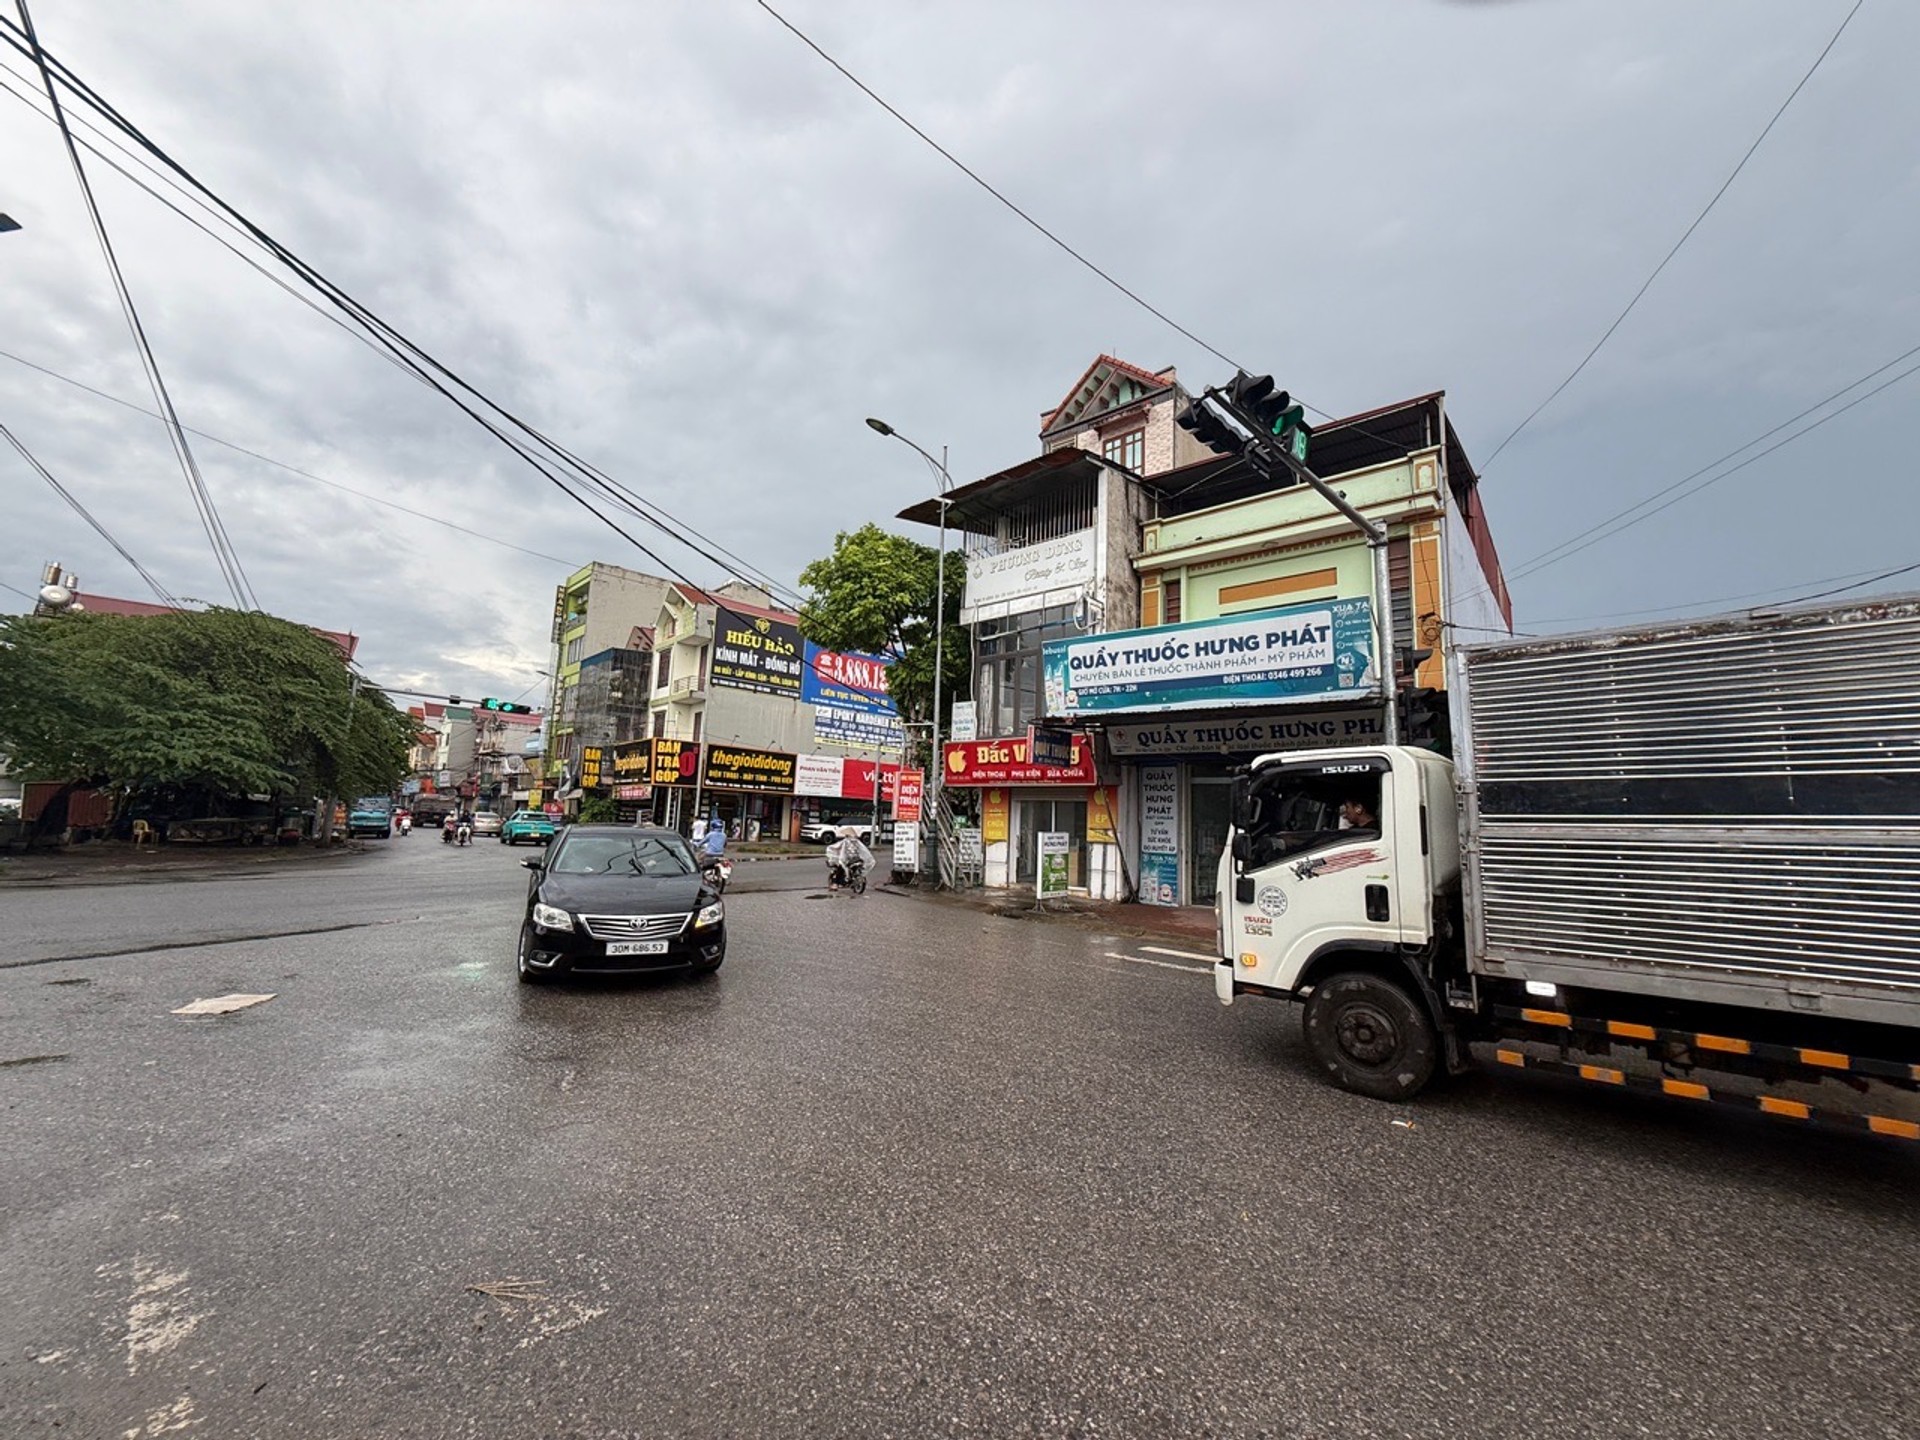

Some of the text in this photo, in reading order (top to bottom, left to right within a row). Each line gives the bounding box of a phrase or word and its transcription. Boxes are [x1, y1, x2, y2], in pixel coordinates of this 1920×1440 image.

[726, 629, 762, 648] HIẾU
[1070, 622, 1331, 671] QUẦY THUỐC HƯNG PHÁT
[715, 646, 738, 663] KÍNH
[740, 650, 758, 667] MẮT
[765, 655, 788, 673] ĐỒNG
[1074, 669, 1110, 682] CHUYÊN
[1112, 667, 1132, 679] BÁN
[1134, 665, 1146, 677] LẺ
[1148, 662, 1182, 676] THUỐC
[1184, 657, 1221, 671] THÀNH
[1224, 653, 1257, 668] PHẨM
[1268, 651, 1285, 664] MỸ
[1289, 647, 1325, 661] PHẨM
[1223, 667, 1322, 685] ĐIỆN THOẠI: 0346 499 266
[1137, 724, 1188, 747] QUẦY
[1193, 720, 1264, 743] THUỐC
[1269, 720, 1336, 739] HƯNG
[657, 740, 682, 754] BÁN
[977, 740, 1009, 764] Đắc
[656, 753, 680, 769] TRẢ
[712, 749, 792, 775] thegioididong
[1322, 763, 1370, 775] ISUZU
[655, 767, 680, 783] GÓP
[1011, 769, 1024, 780] PHỤ
[1026, 768, 1041, 778] KIỆN
[1047, 766, 1062, 778] SỬA
[1062, 767, 1084, 778] CHỮA
[1146, 772, 1173, 780] QUẦY
[1143, 782, 1176, 792] THUỐC
[1146, 794, 1173, 804] HƯNG
[1147, 804, 1172, 815] PHÁT
[1244, 916, 1273, 924] ISUZU
